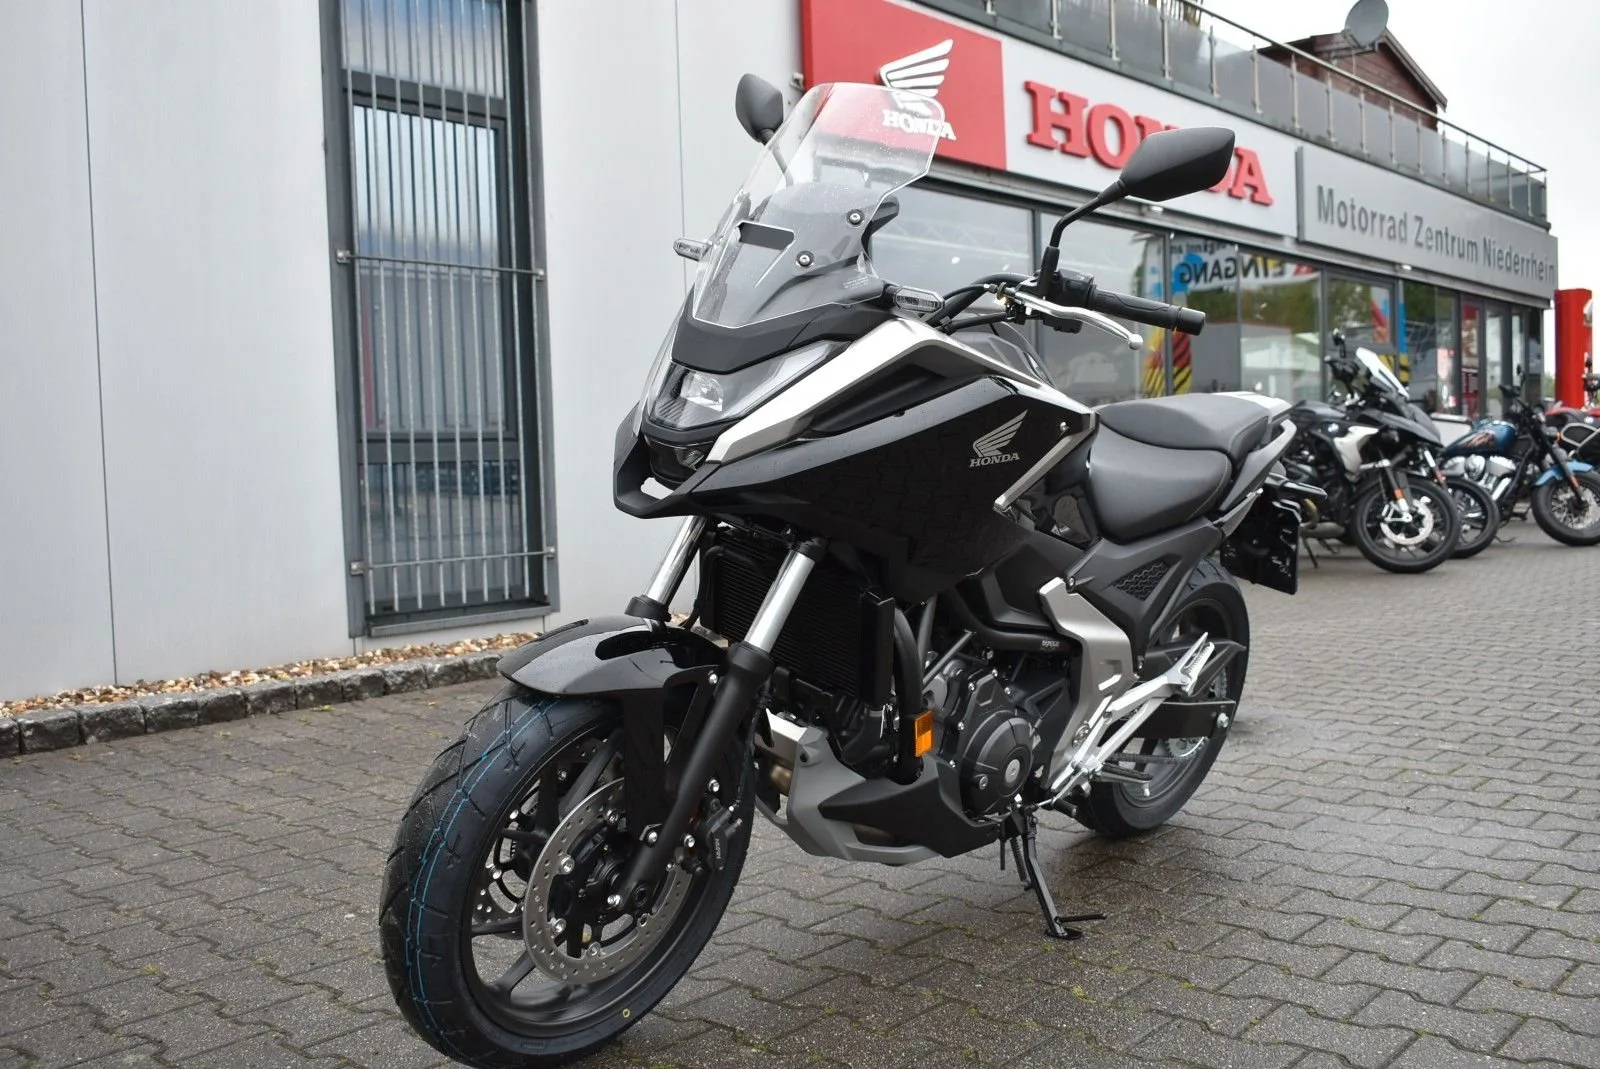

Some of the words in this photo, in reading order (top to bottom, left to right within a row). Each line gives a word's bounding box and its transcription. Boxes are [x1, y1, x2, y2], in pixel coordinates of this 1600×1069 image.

[881, 109, 957, 141] HONDA
[1317, 185, 1408, 244] Motorrad
[1414, 215, 1479, 263] Zentrum
[1482, 237, 1556, 286] Niederrhein
[969, 452, 1021, 468] HONDA
